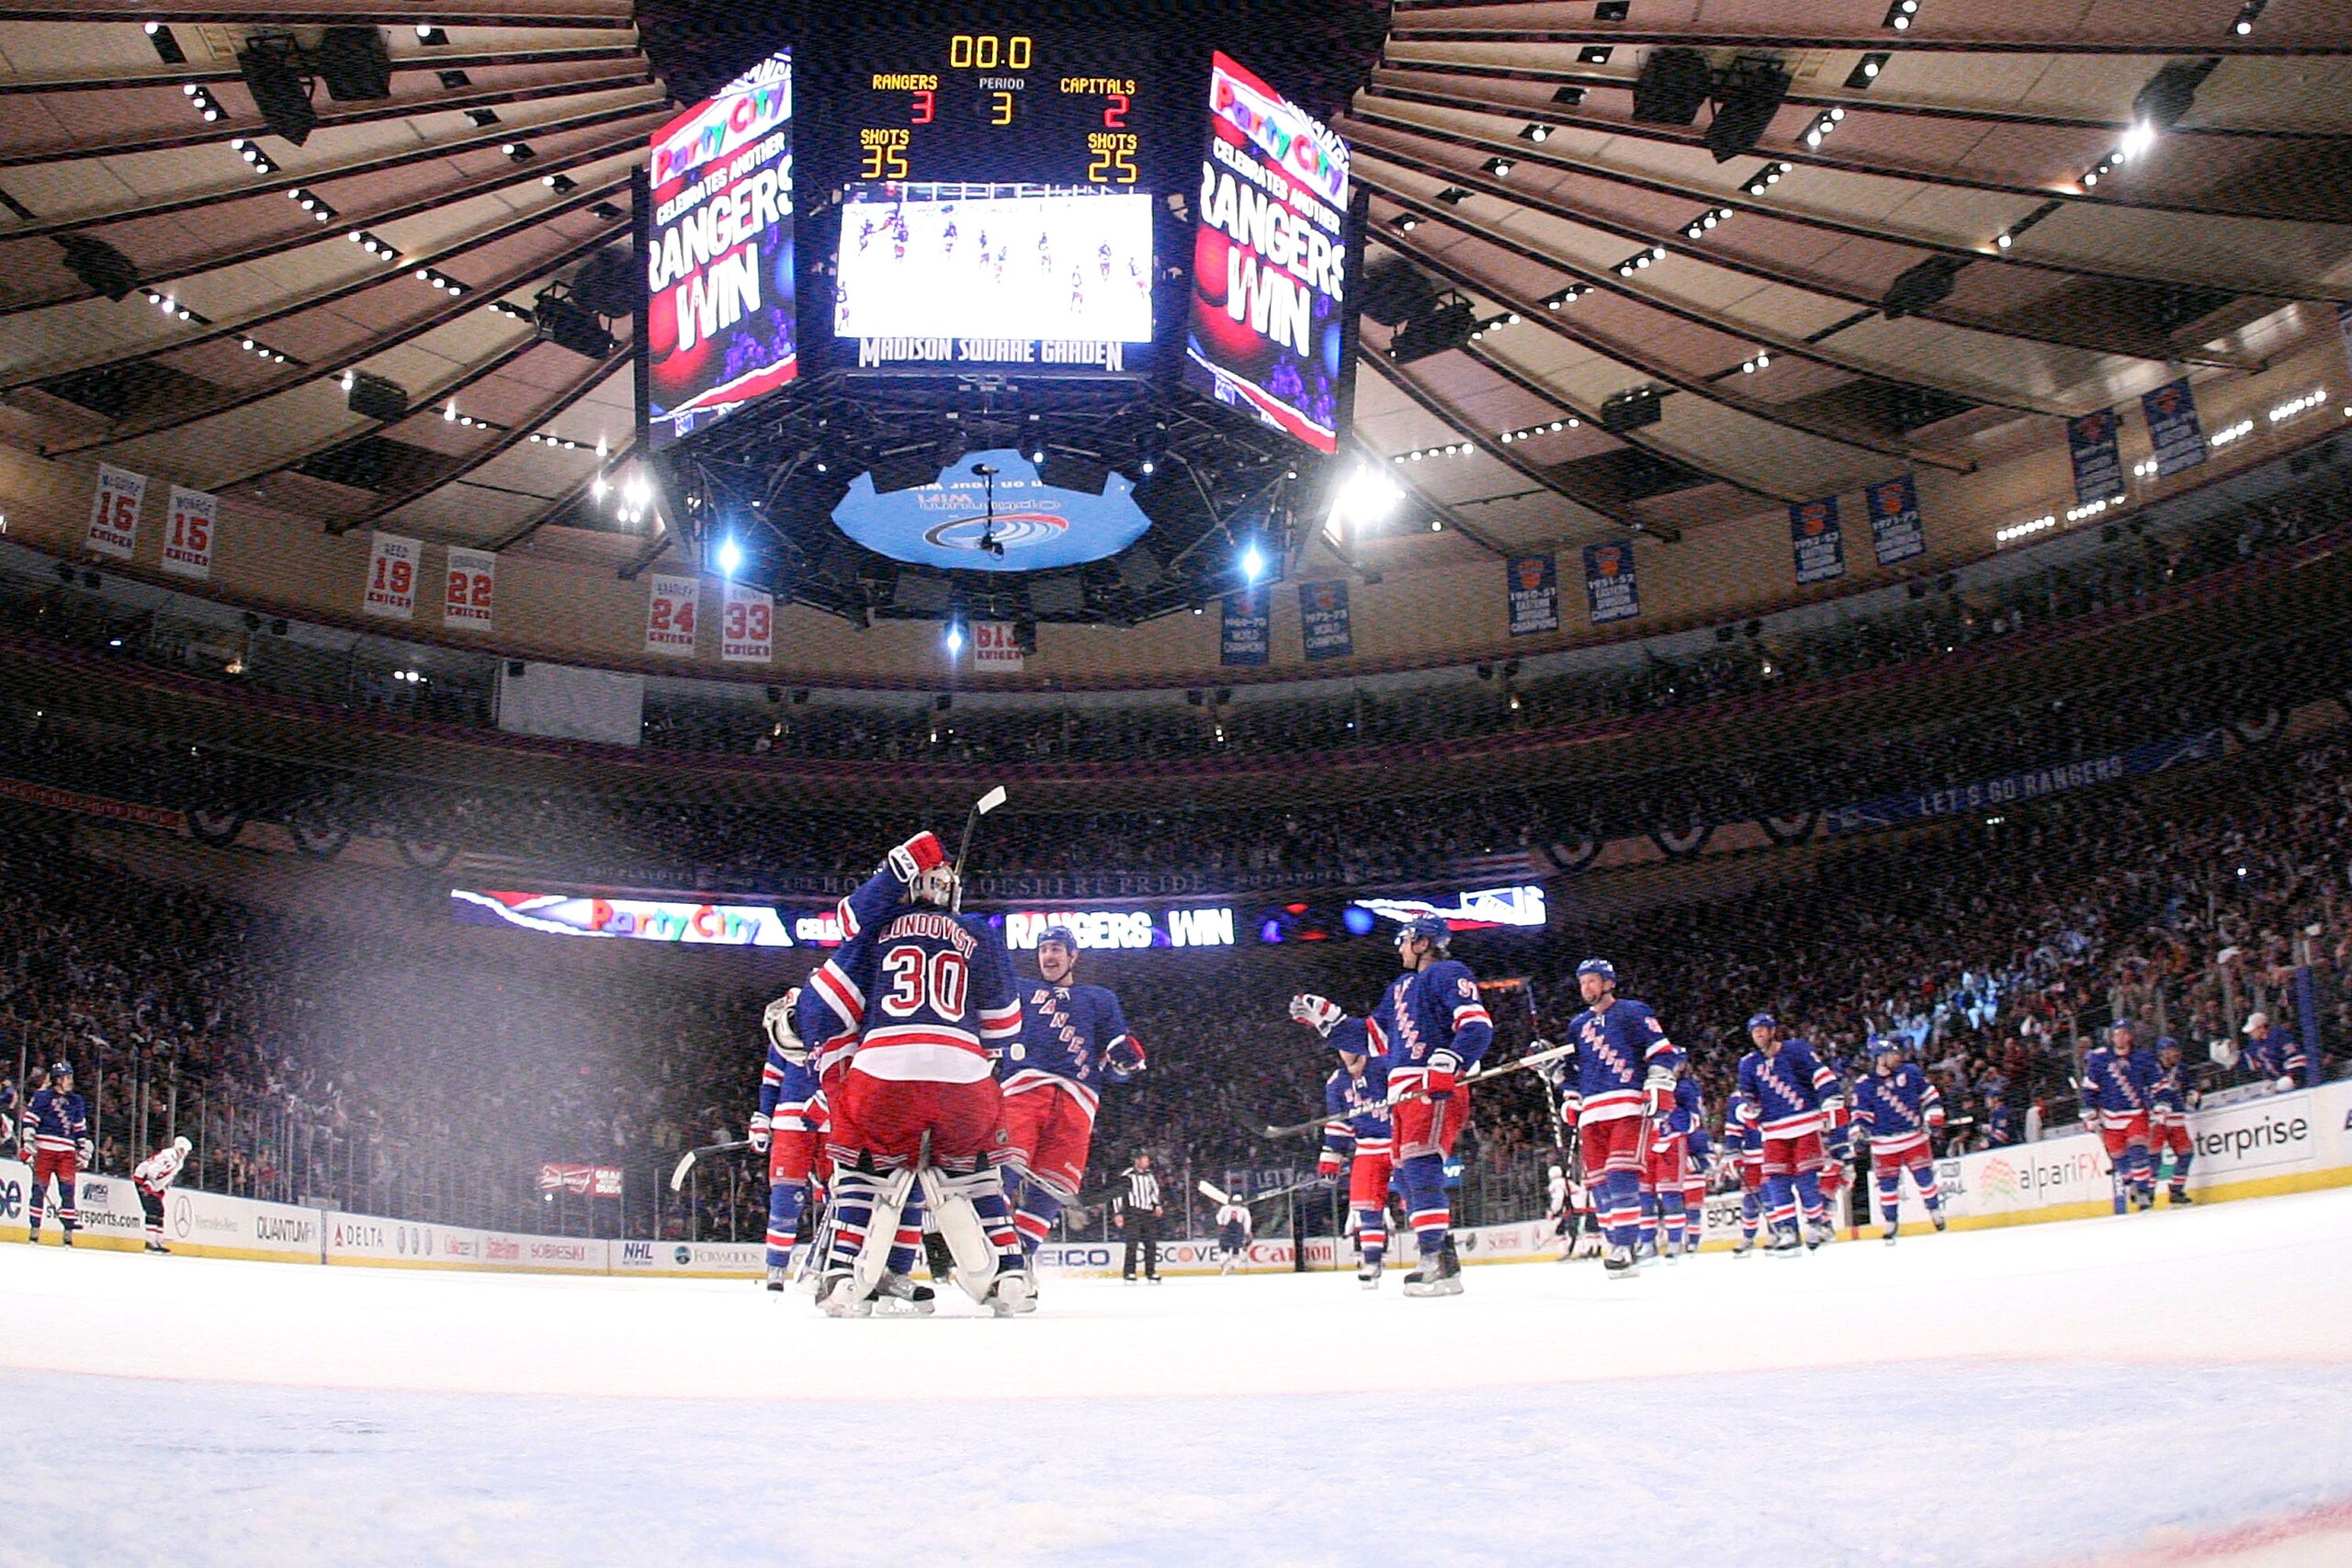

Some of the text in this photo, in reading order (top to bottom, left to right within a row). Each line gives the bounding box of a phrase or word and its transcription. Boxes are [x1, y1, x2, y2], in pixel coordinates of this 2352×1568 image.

[950, 35, 1031, 69] 00.0
[873, 74, 938, 90] RANGERS
[979, 77, 1024, 89] PERIOD
[1060, 78, 1136, 95] CAPITALS
[911, 91, 934, 123] 3
[991, 92, 1012, 125] 3
[1104, 95, 1130, 128] 2
[656, 81, 786, 184] Party City
[861, 129, 910, 144] SHOTS
[1088, 133, 1136, 150] SHOTS
[1216, 77, 1291, 161] Party
[1293, 134, 1343, 197] City
[861, 145, 908, 177] 35
[1089, 149, 1136, 183] 25
[657, 132, 786, 226] CELEBRATES ANOTHER
[1213, 137, 1341, 236] CELEBRATES ANOTHER
[675, 243, 761, 351] WIN
[1227, 246, 1311, 356] WIN
[859, 337, 1123, 371] MADISON SQUARE GARDEN
[374, 558, 412, 593] 19
[447, 571, 492, 606] 22
[650, 597, 695, 632] 24
[724, 603, 770, 639] 33
[2024, 756, 2124, 795] RANGERS
[592, 898, 686, 942] Party
[692, 904, 762, 944] City
[1169, 908, 1235, 948] WIN
[881, 945, 969, 1022] 30
[345, 1224, 384, 1247] DELTA
[624, 1243, 653, 1259] NHL
[1039, 1247, 1110, 1266] EICO
